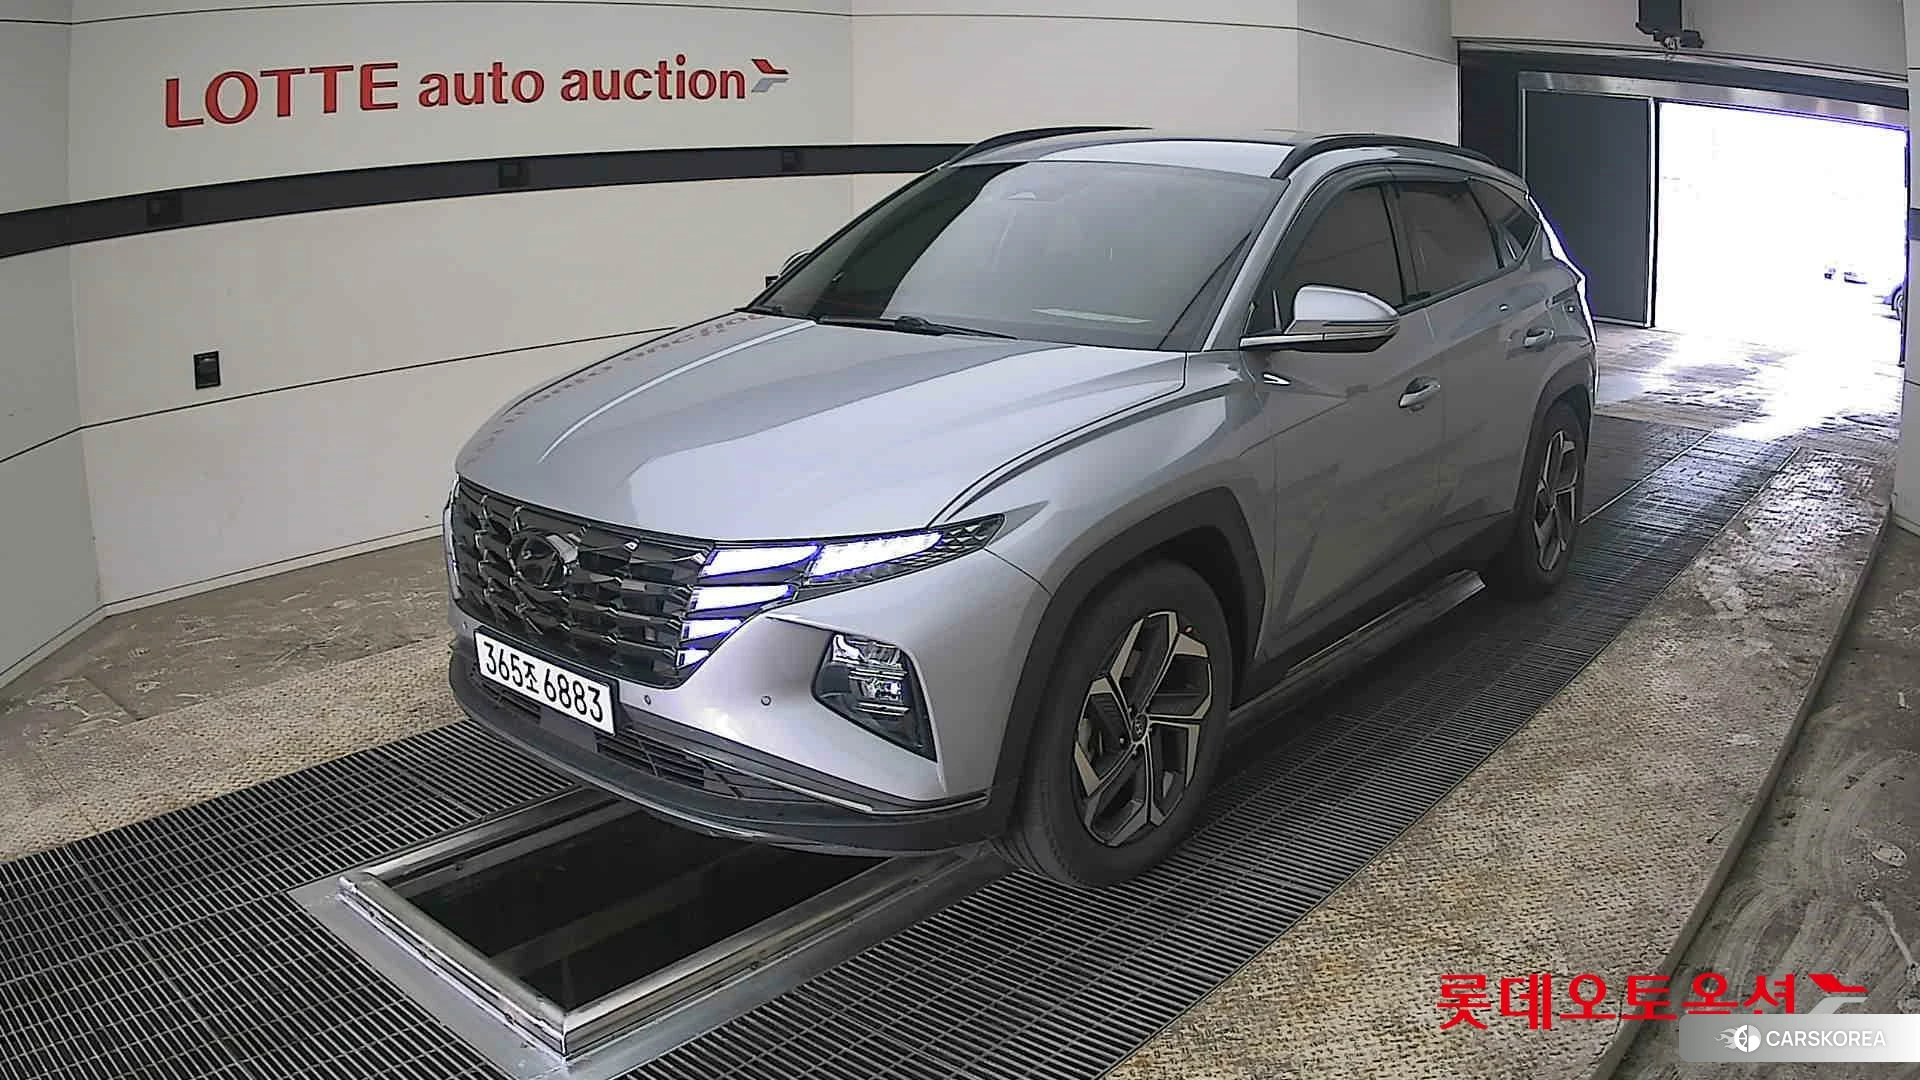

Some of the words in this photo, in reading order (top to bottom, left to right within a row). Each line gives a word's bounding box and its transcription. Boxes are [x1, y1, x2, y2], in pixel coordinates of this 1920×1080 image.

[164, 62, 399, 128] LOTTE
[418, 62, 545, 108] auto
[560, 54, 746, 101] auction
